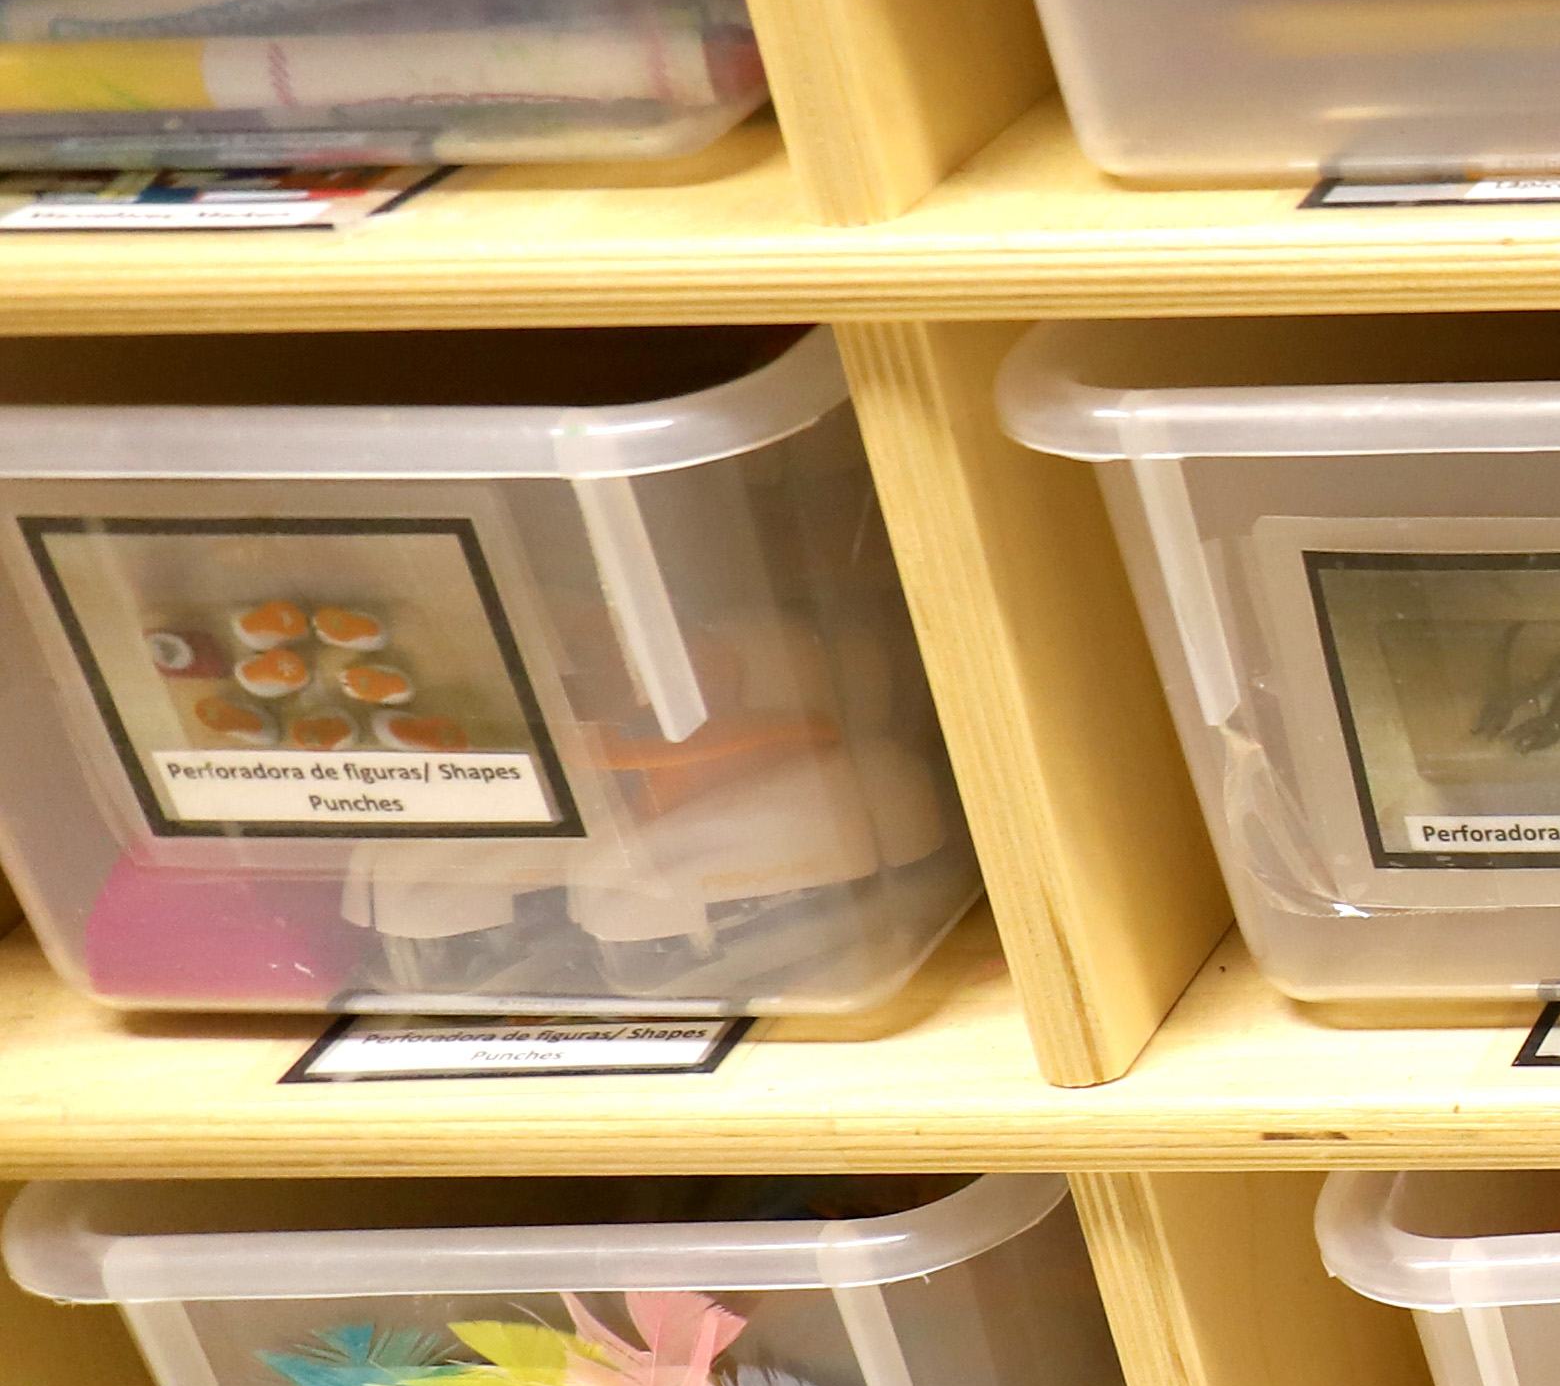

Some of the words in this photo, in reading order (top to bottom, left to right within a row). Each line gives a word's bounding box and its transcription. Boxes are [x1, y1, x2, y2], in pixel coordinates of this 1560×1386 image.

[168, 763, 304, 781] Perforadora
[311, 763, 338, 781] de
[345, 763, 431, 785] figuras/
[438, 763, 521, 784] Shapes
[308, 794, 404, 812] Punches
[363, 1030, 496, 1045] Perforadora
[503, 1029, 529, 1043] de
[540, 1027, 622, 1044] figuras/
[632, 1027, 707, 1040] Shapes
[471, 1050, 564, 1061] Punches
